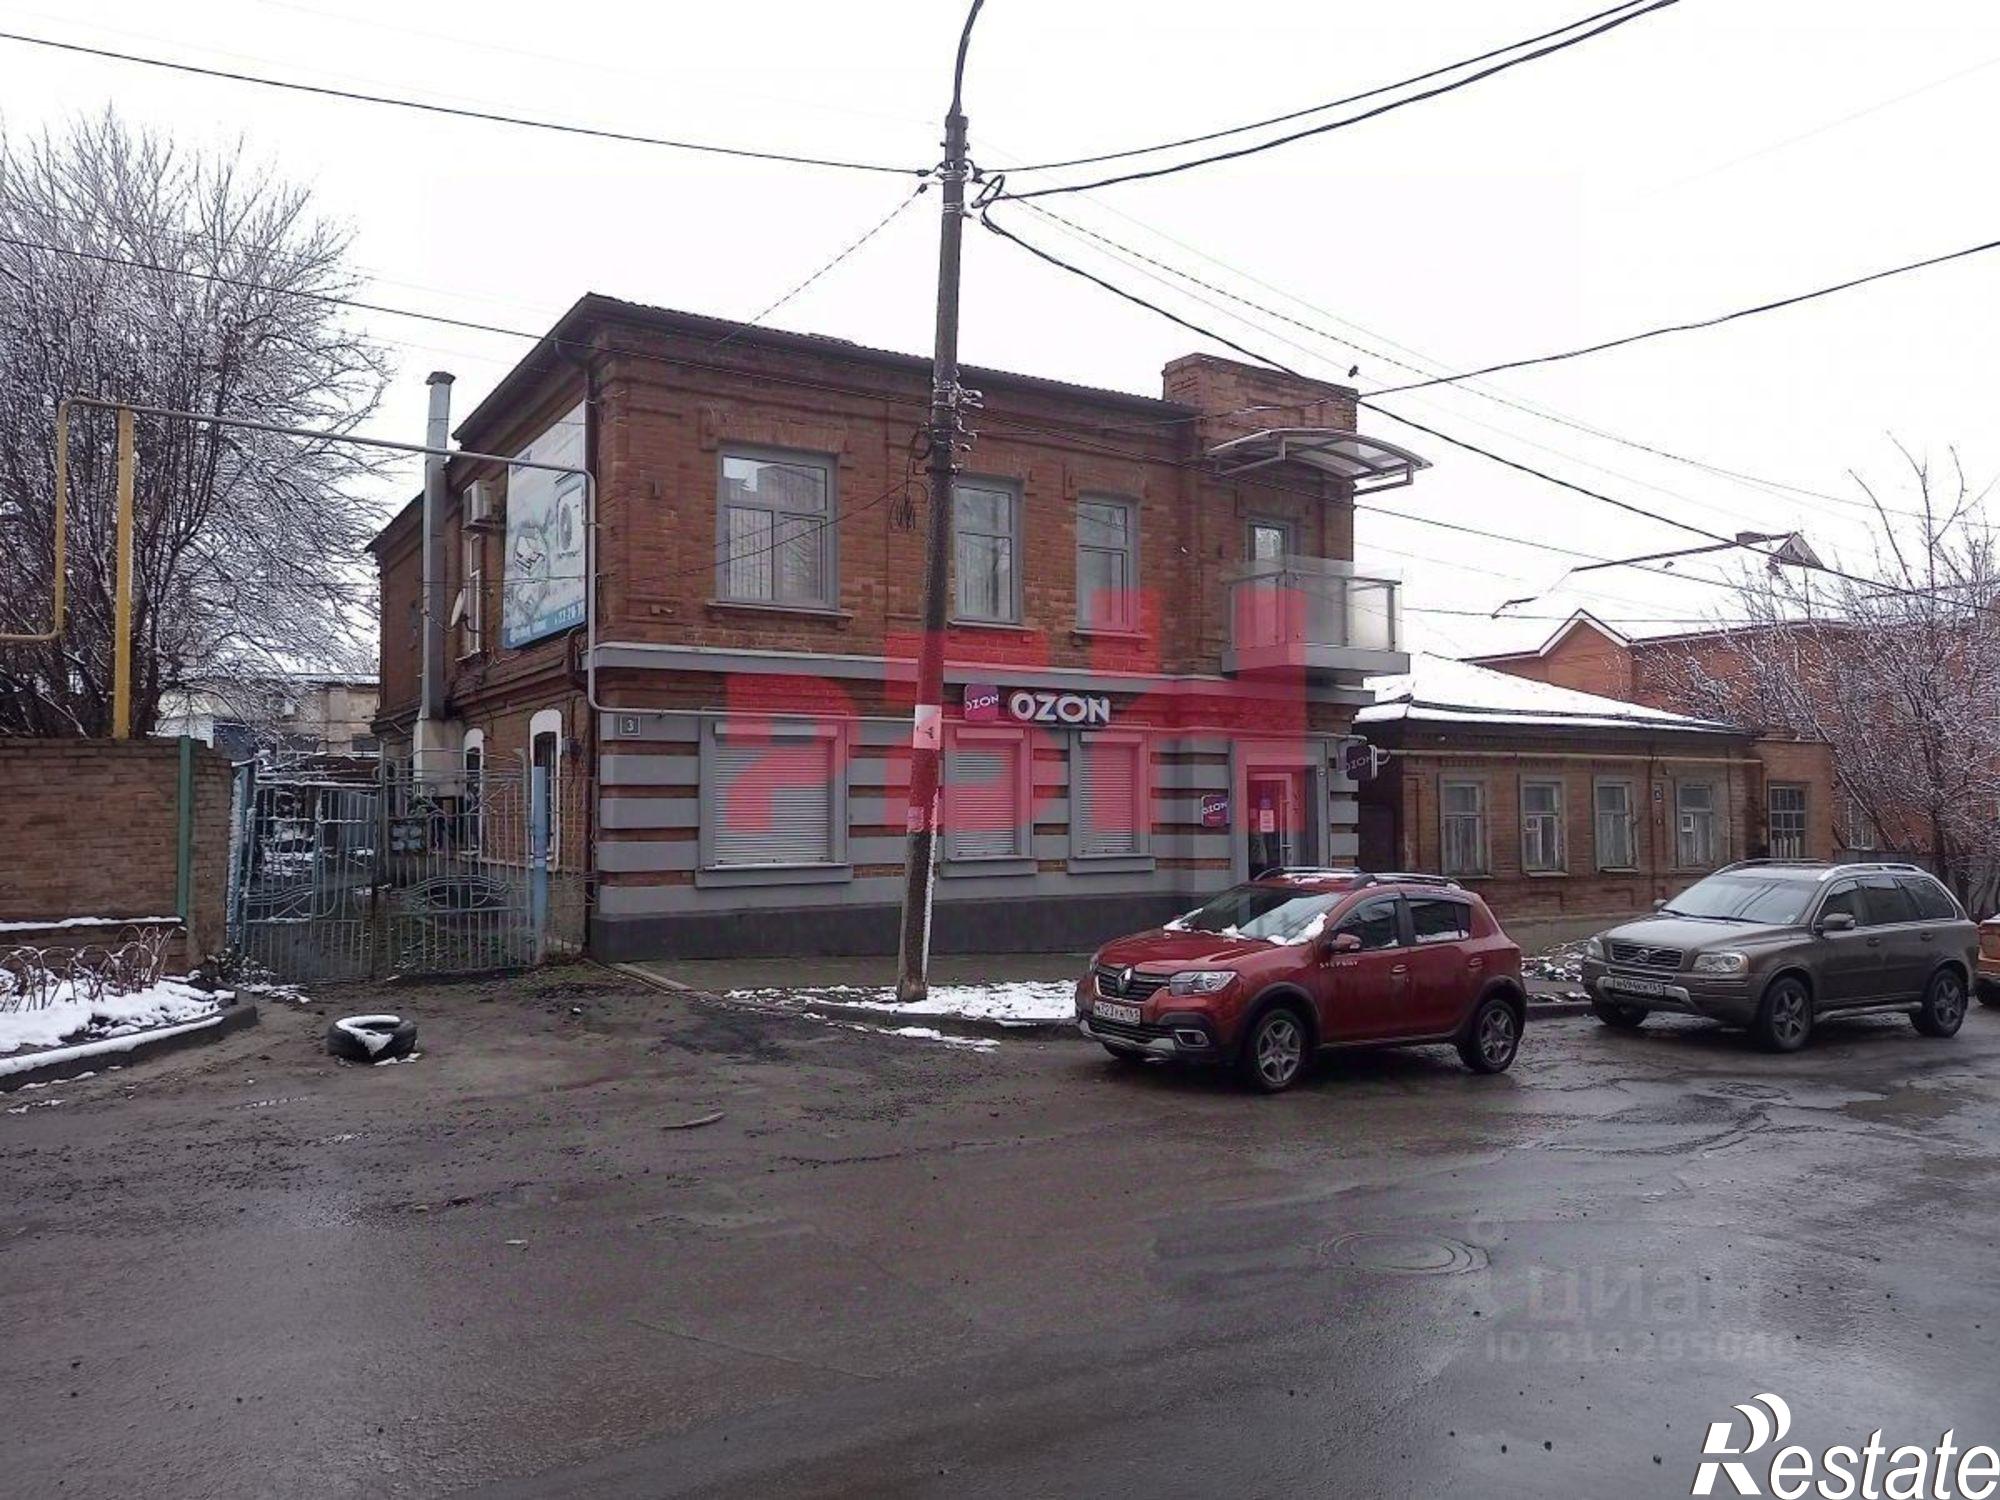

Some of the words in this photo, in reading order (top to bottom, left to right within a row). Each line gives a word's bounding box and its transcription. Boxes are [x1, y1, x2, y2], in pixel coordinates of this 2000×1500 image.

[964, 694, 1000, 711] OZON
[1010, 691, 1111, 724] OZON
[626, 719, 635, 732] 3
